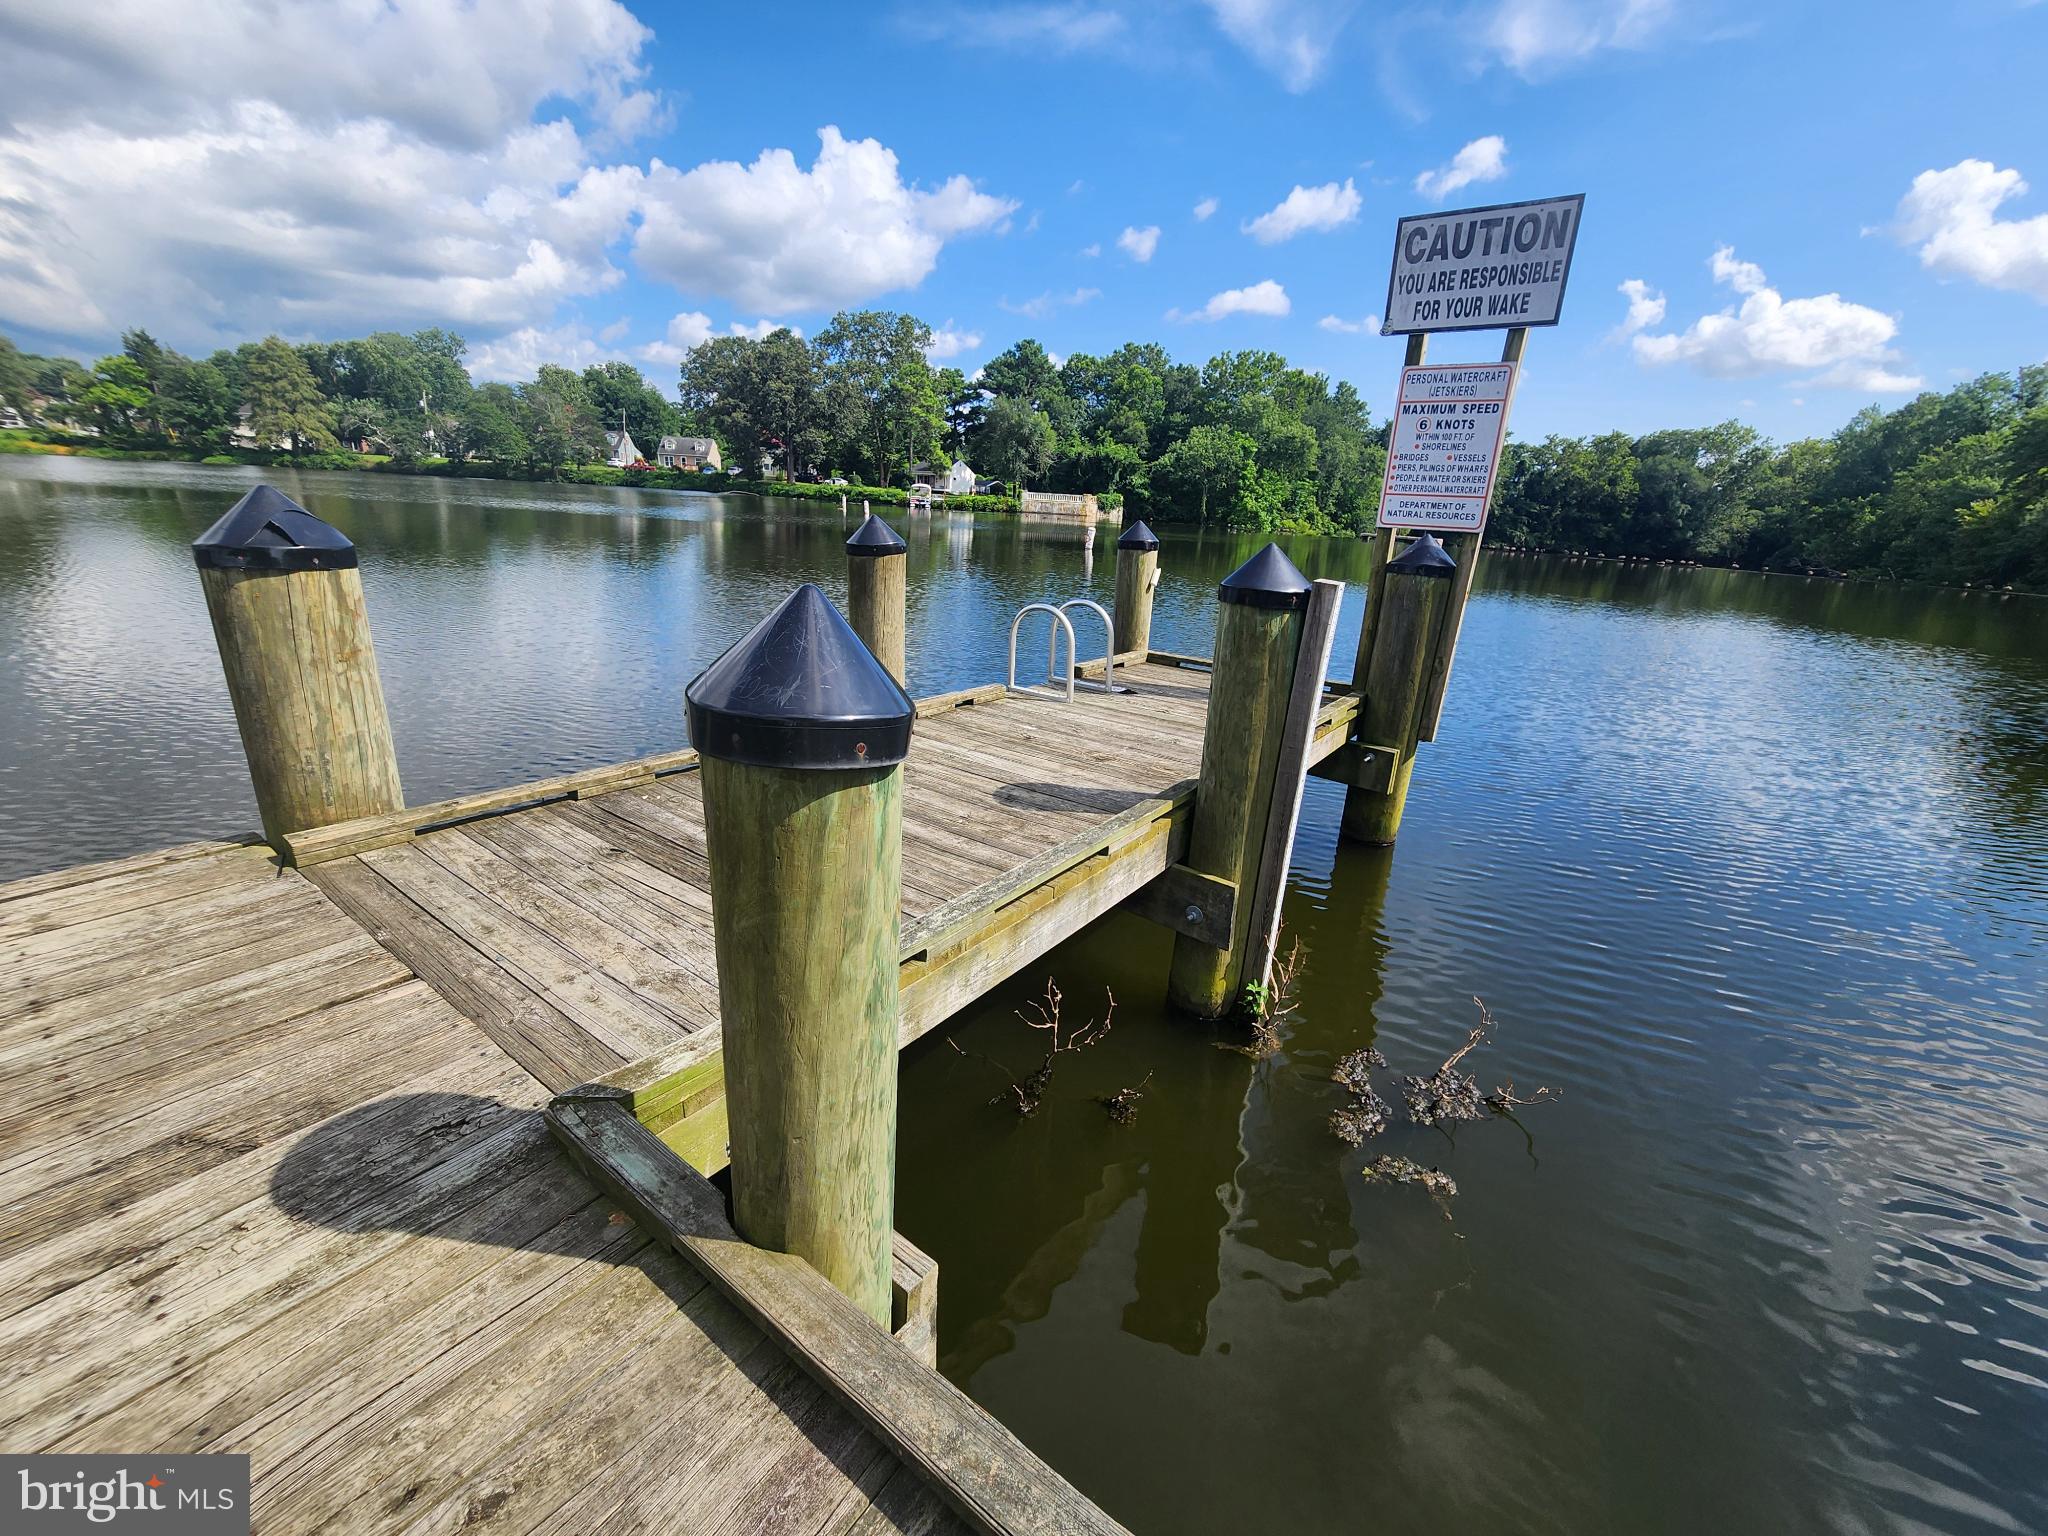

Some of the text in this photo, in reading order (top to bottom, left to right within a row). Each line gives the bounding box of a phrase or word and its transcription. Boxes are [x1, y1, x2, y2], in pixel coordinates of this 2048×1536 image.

[1404, 208, 1572, 264] CAUTION
[1398, 259, 1563, 295] YOU ARE RESPONSIBLE
[1413, 292, 1531, 321] FOR YOUR WAKE
[1406, 370, 1508, 384] PERSONAL WATERCRAFT
[1428, 384, 1478, 398] (JETSKIERS)
[1402, 403, 1500, 415] MAXIMUM SPEED
[1419, 419, 1475, 430] 6 KNOTS
[1415, 432, 1440, 441] WITHIN
[1441, 432, 1452, 441] 100
[1464, 433, 1475, 441] OF
[1421, 442, 1467, 451] SHORELINES
[1453, 454, 1487, 462] VESSELS
[1418, 464, 1445, 472] PILINGS
[1457, 465, 1489, 473] WHARFS
[1395, 474, 1420, 482] PEOPLE
[1428, 475, 1451, 483] WATER
[1451, 475, 1461, 483] OR
[1462, 476, 1487, 484] SKIERS
[1413, 485, 1443, 493] PERSONAL
[1444, 486, 1485, 494] WATERCRAFT
[1399, 500, 1467, 510] DEPARTMENT OF
[1386, 510, 1477, 521] NATURAL RESOURCES
